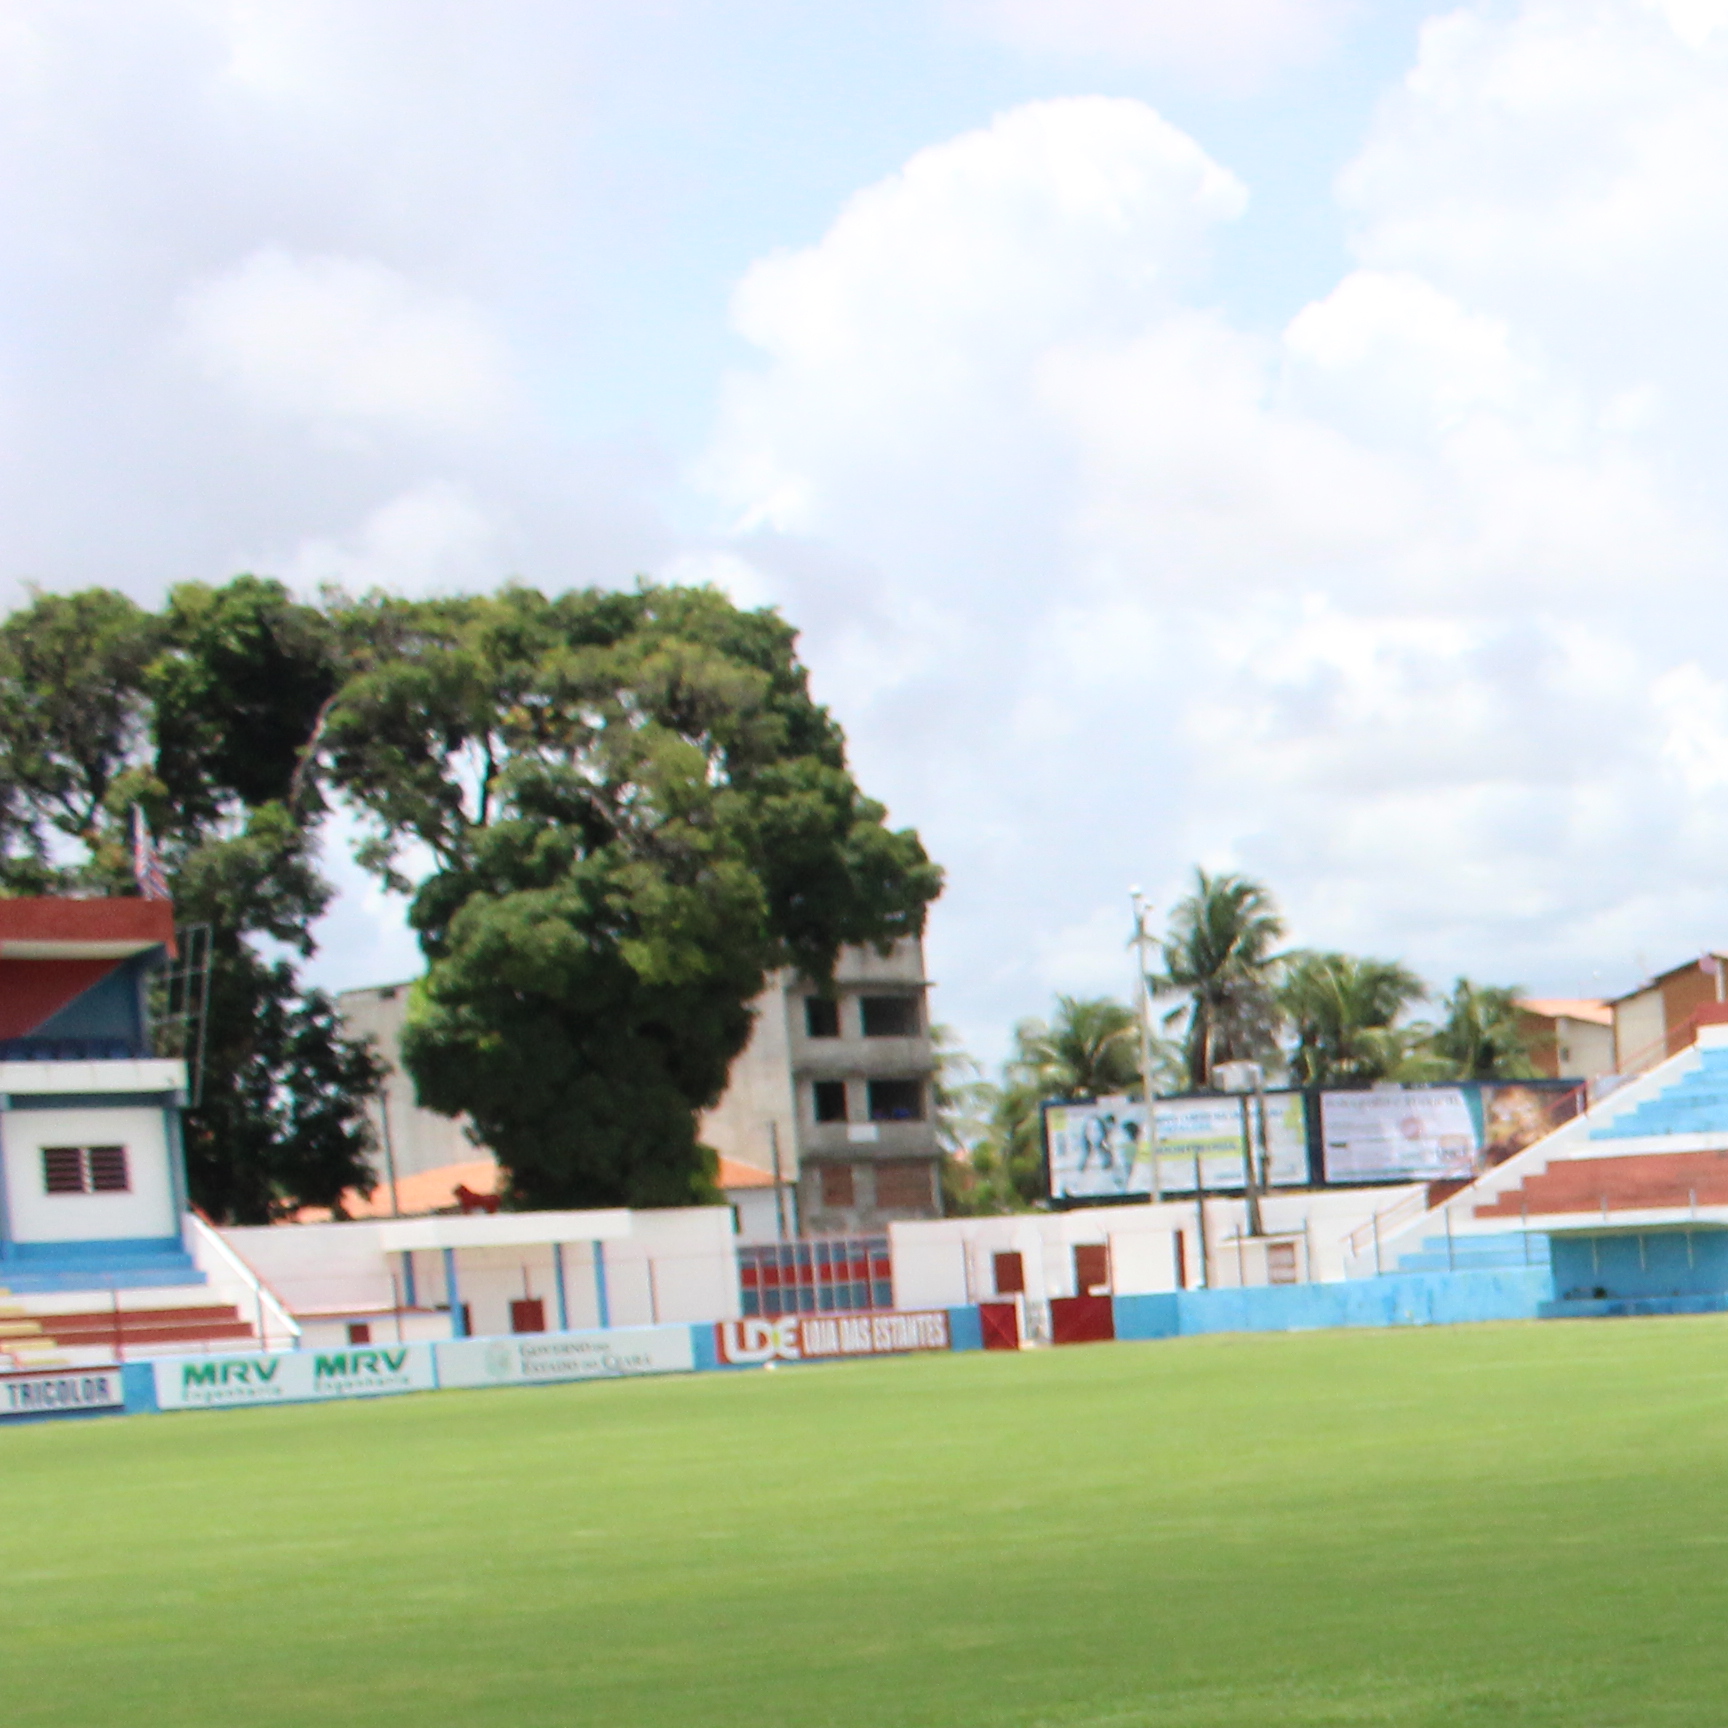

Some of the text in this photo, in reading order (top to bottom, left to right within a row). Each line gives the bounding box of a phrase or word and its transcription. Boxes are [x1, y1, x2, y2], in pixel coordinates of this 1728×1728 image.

[722, 1315, 799, 1364] LDE
[182, 1356, 280, 1387] MRV
[314, 1348, 407, 1378] MRV
[8, 1376, 110, 1409] TRICOLOR
